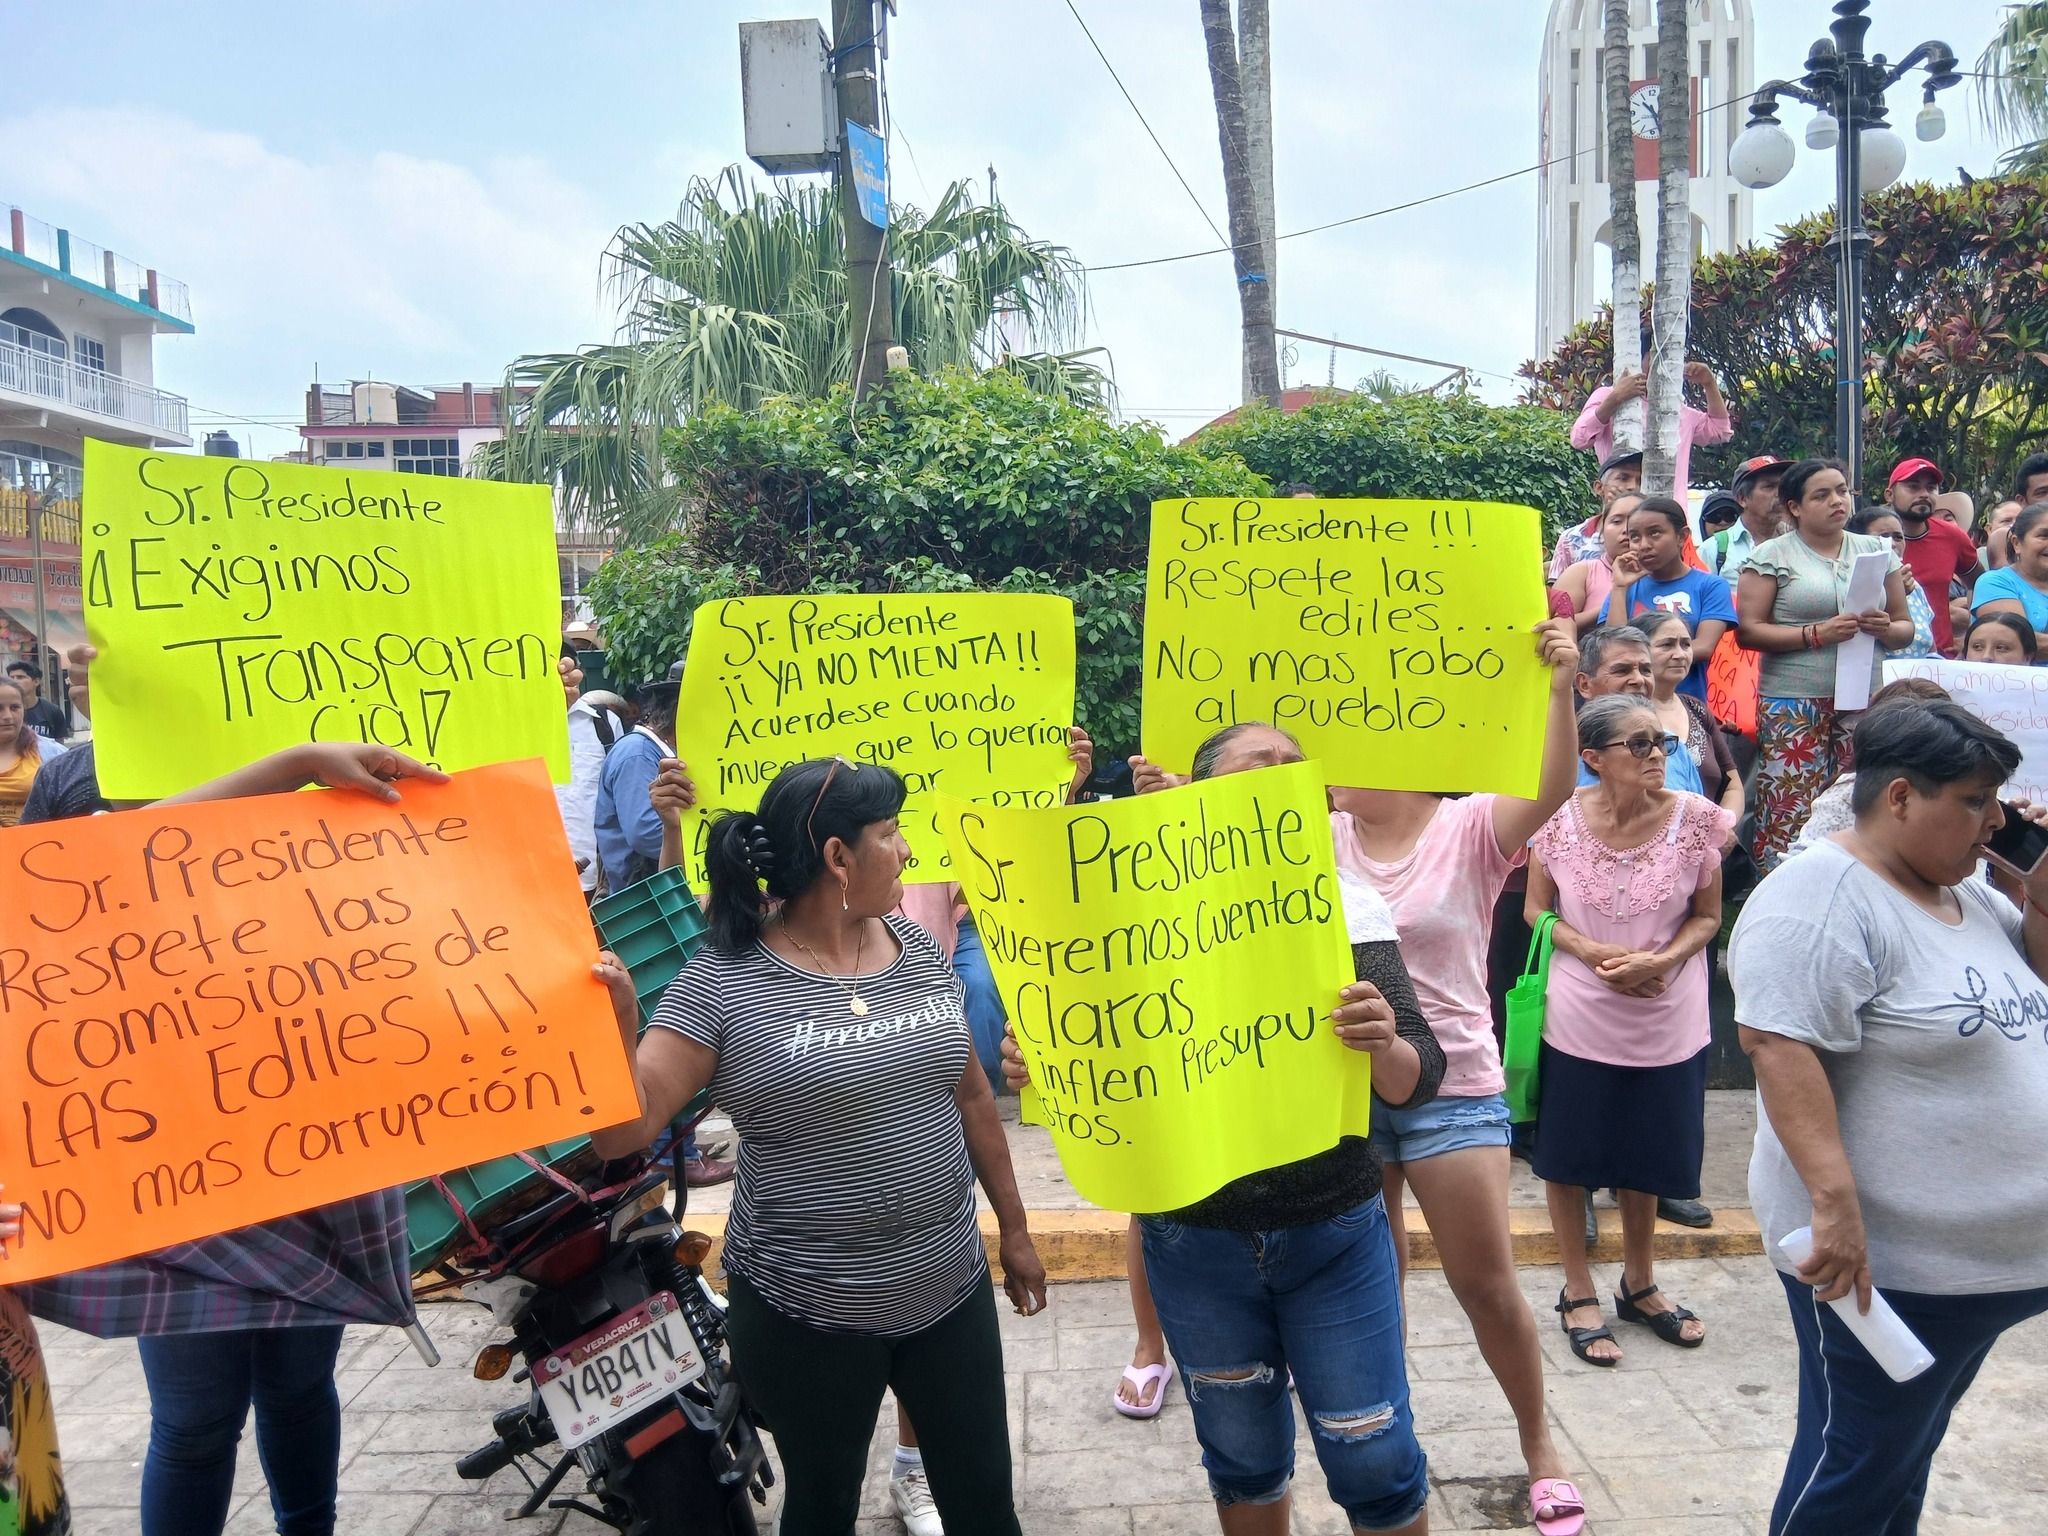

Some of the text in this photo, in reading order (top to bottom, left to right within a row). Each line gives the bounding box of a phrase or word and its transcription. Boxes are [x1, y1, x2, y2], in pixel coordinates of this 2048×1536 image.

[139, 457, 445, 526] Sr. Presidente
[1180, 501, 1224, 552] Sr.
[1233, 501, 1409, 545] Presidente
[1165, 557, 1445, 609] Respete las
[719, 599, 959, 668] Sr. Presidente
[1249, 649, 1356, 686] mas
[1390, 636, 1505, 681] robo
[817, 652, 859, 688] NO
[724, 698, 890, 749] Acuerdese
[1195, 689, 1238, 727] al
[856, 734, 913, 768] que
[932, 721, 958, 751] lo
[20, 812, 469, 933] Sr. Presidente
[960, 797, 1312, 904] Sr. Presidente
[0, 886, 413, 1012] Respete las
[435, 908, 510, 968] de
[978, 908, 1190, 978] Queremos
[1016, 977, 1196, 1050] Claras
[1036, 1050, 1159, 1107] inflen
[22, 1079, 159, 1169] LAS
[131, 1140, 244, 1215] mas
[558, 1321, 676, 1413] Y4B47V
[581, 1316, 641, 1355] VERACRUZ
